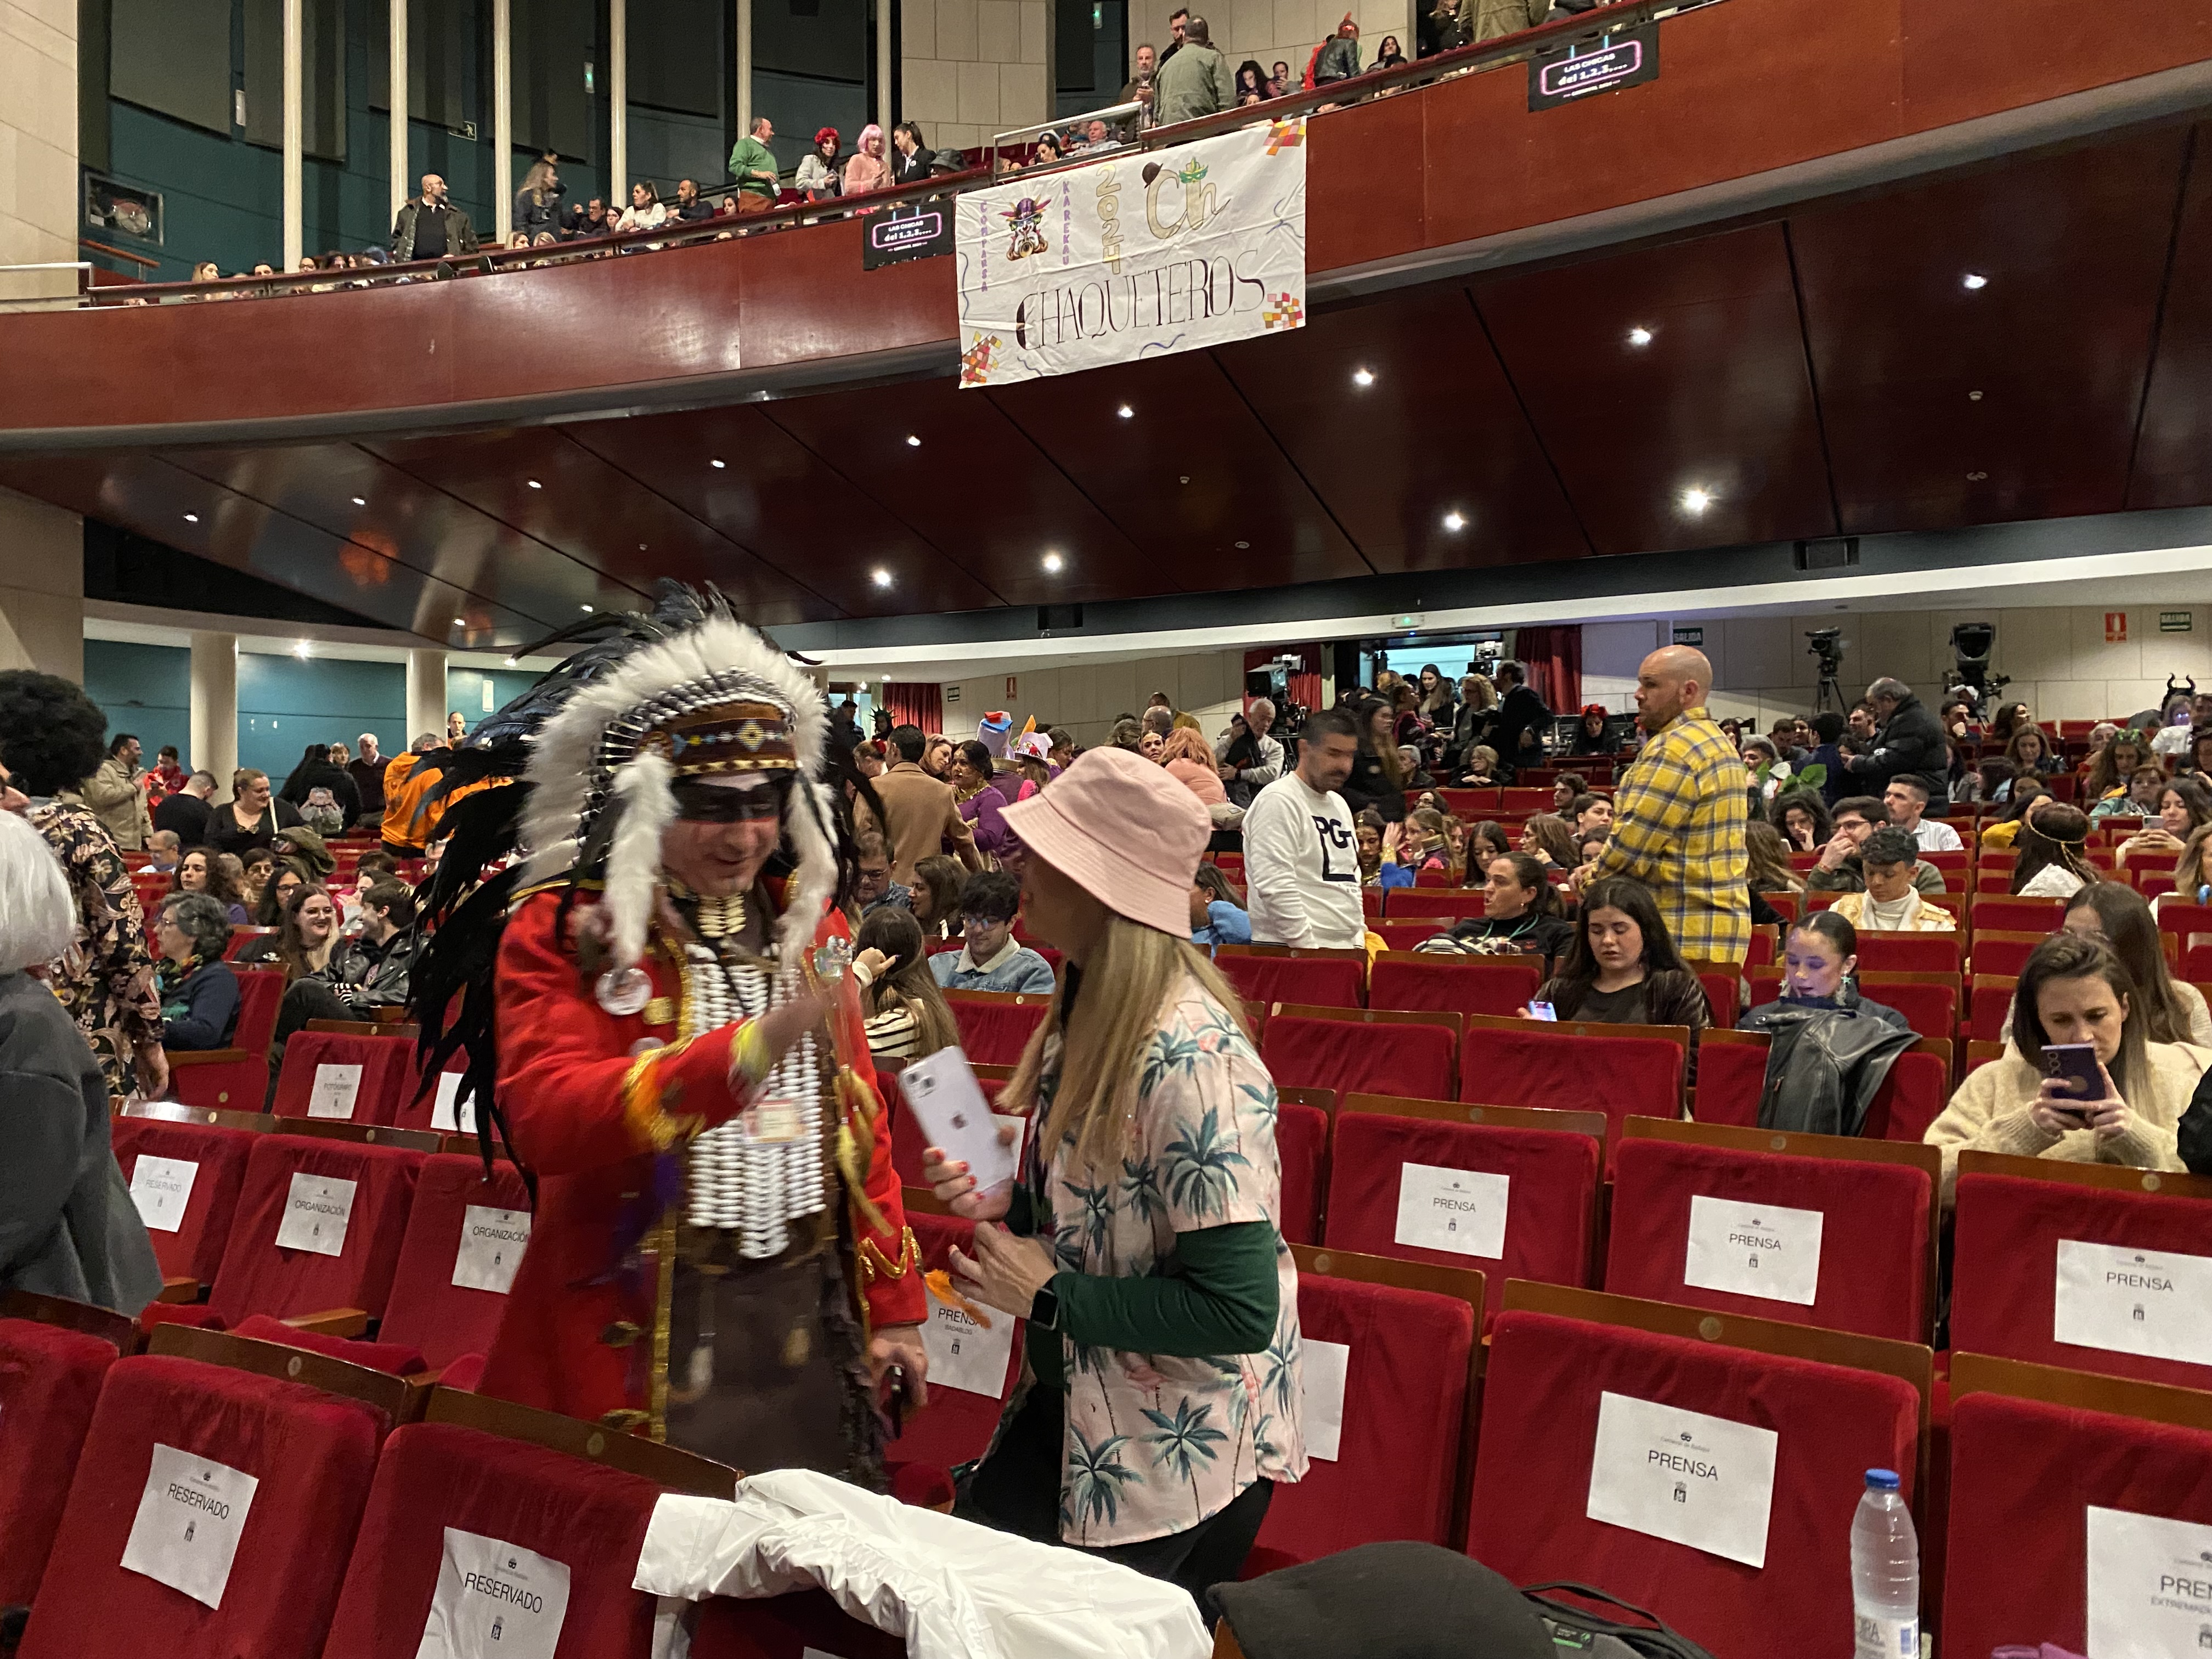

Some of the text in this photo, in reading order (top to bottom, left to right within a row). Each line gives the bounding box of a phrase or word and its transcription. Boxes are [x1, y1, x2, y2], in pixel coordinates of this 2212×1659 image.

[1564, 53, 1616, 73] LAS CHICAS
[1558, 74, 1577, 86] del
[900, 220, 924, 229] CHICAS
[1062, 180, 1071, 266] KAREKAU
[1096, 163, 1124, 275] 2024
[884, 232, 898, 242] del
[980, 200, 988, 292] COMPARSA
[1015, 249, 1265, 351] CHAQUETEROS
[145, 1179, 182, 1192] RESERVADO
[295, 1200, 346, 1217] ORGANIZACIÓN
[1432, 1197, 1476, 1212] PRENSA
[1729, 1233, 1782, 1251] PRENSA
[2107, 1272, 2174, 1292] PRENSA
[938, 1308, 984, 1327] PRENS
[1649, 1450, 1719, 1481] PRENSA
[167, 1483, 230, 1520] RESERVADO
[465, 1572, 543, 1614] RESERVADO
